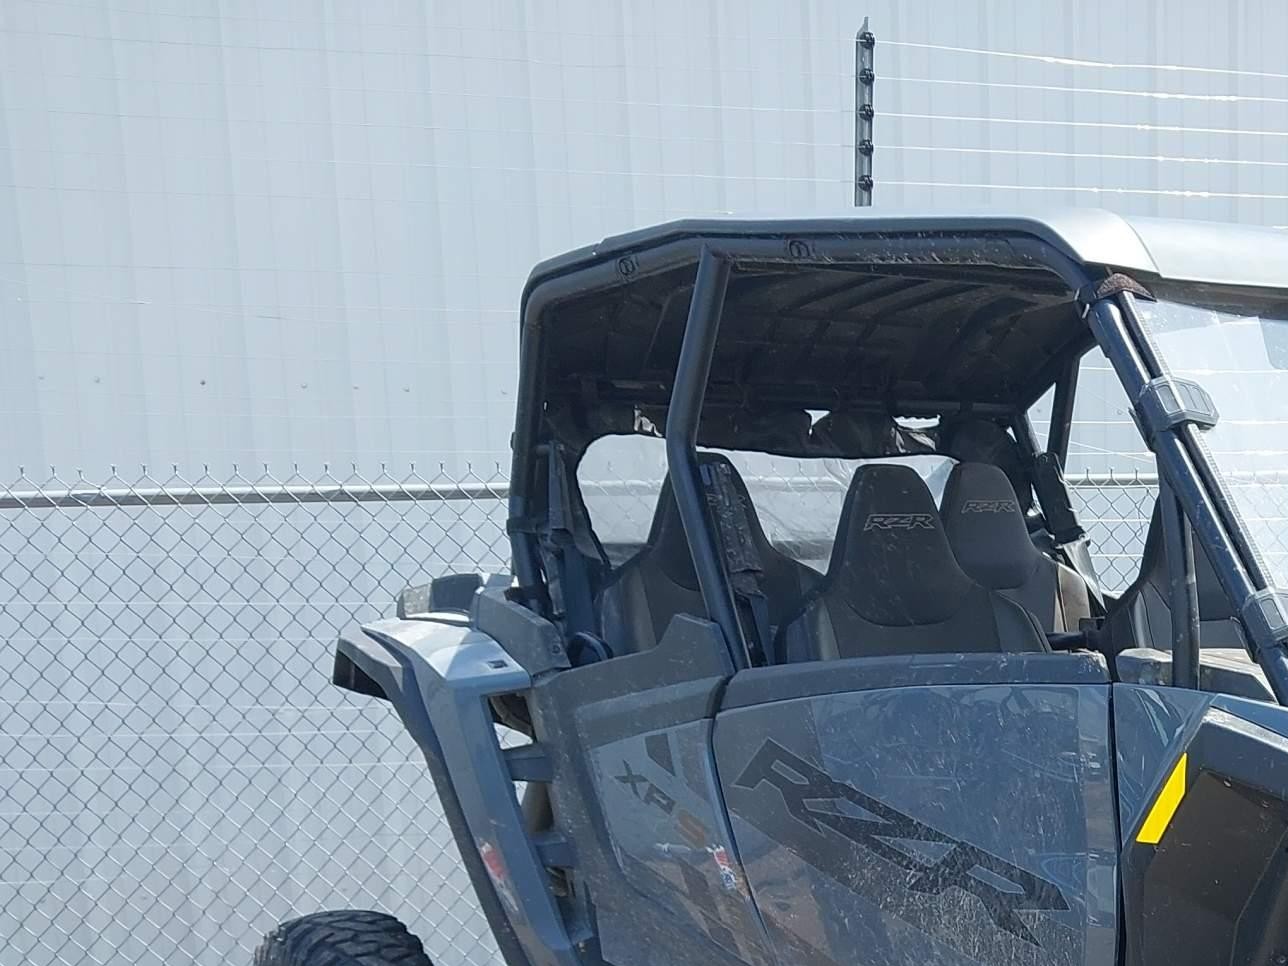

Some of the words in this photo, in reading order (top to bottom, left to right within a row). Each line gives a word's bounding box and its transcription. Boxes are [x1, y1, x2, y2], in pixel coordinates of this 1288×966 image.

[961, 500, 1016, 513] RZR
[863, 513, 935, 531] RZR
[731, 737, 1071, 947] RZR
